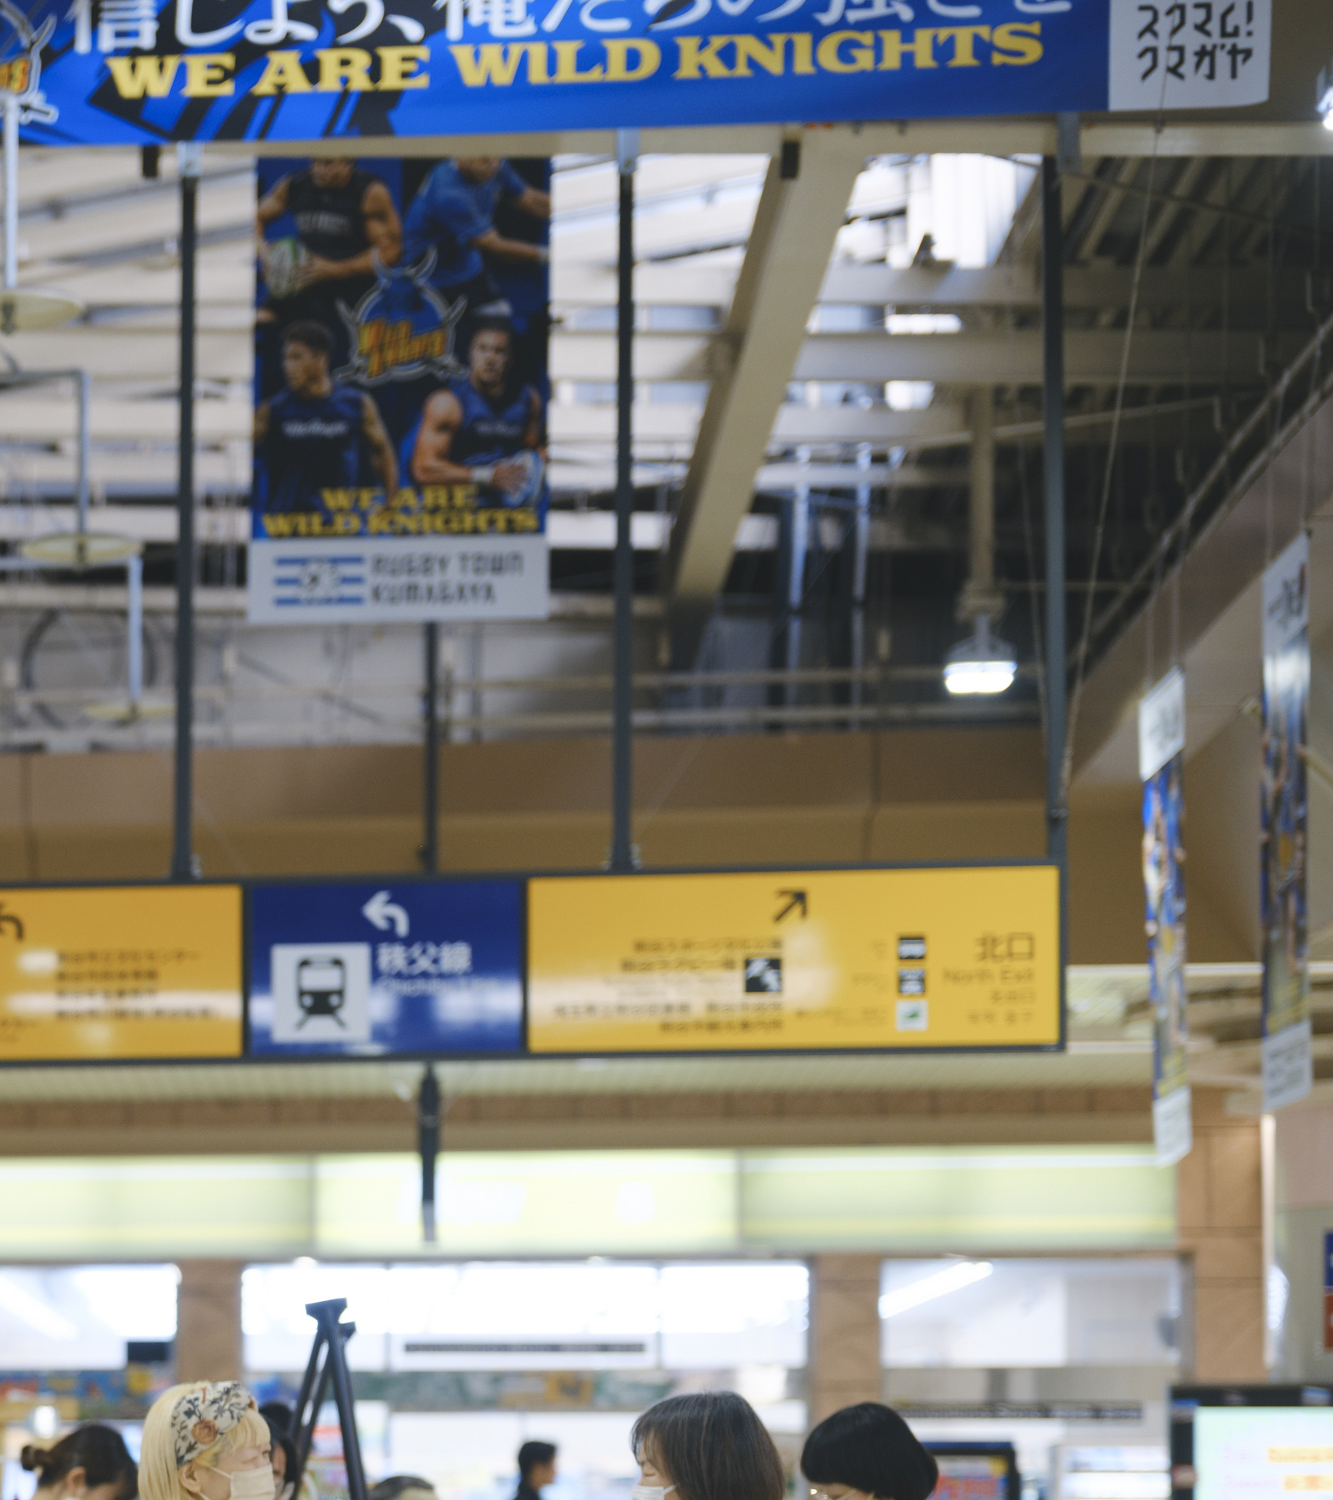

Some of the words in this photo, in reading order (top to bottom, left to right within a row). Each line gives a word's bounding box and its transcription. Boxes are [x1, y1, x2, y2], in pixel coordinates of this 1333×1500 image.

[104, 50, 237, 98] WE
[252, 44, 431, 95] ARE
[449, 37, 662, 87] WILD
[674, 21, 1044, 79] KNIGHTS
[1139, 43, 1254, 81] クマガヤ
[367, 508, 539, 535] KNIGHTS
[371, 581, 497, 605] KUMAGAYA
